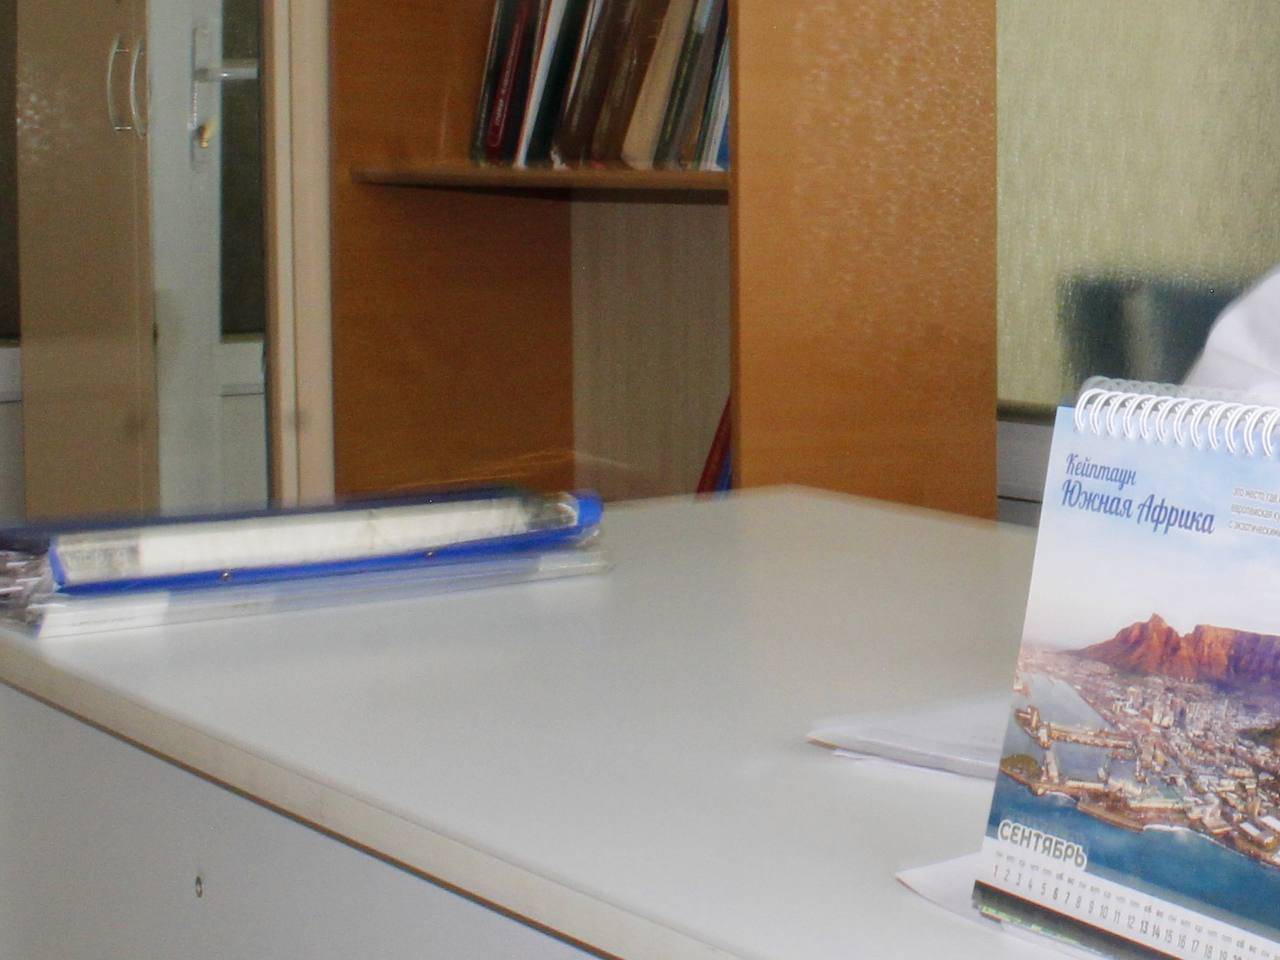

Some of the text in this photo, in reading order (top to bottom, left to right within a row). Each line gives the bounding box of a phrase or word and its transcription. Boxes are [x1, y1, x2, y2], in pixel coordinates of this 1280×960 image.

[1066, 453, 1137, 490] Кейптаун
[1062, 479, 1216, 534] Южная Африка
[1000, 822, 1085, 868] СЕНТЯБРЬ
[994, 864, 999, 878] 1
[1004, 868, 1010, 882] 2
[1016, 873, 1022, 886] 3
[1041, 882, 1046, 896] 5
[1053, 887, 1059, 900] 6
[1065, 892, 1070, 904] 7
[1076, 896, 1082, 909] 8
[1088, 900, 1094, 914] 9
[1100, 904, 1108, 919] 10
[1113, 910, 1120, 924] 11
[1127, 915, 1136, 930] 12
[1140, 920, 1149, 934] 13
[1152, 924, 1160, 938] 14
[1165, 929, 1174, 944] 15
[1178, 934, 1186, 948] 16
[1191, 939, 1200, 953] 17
